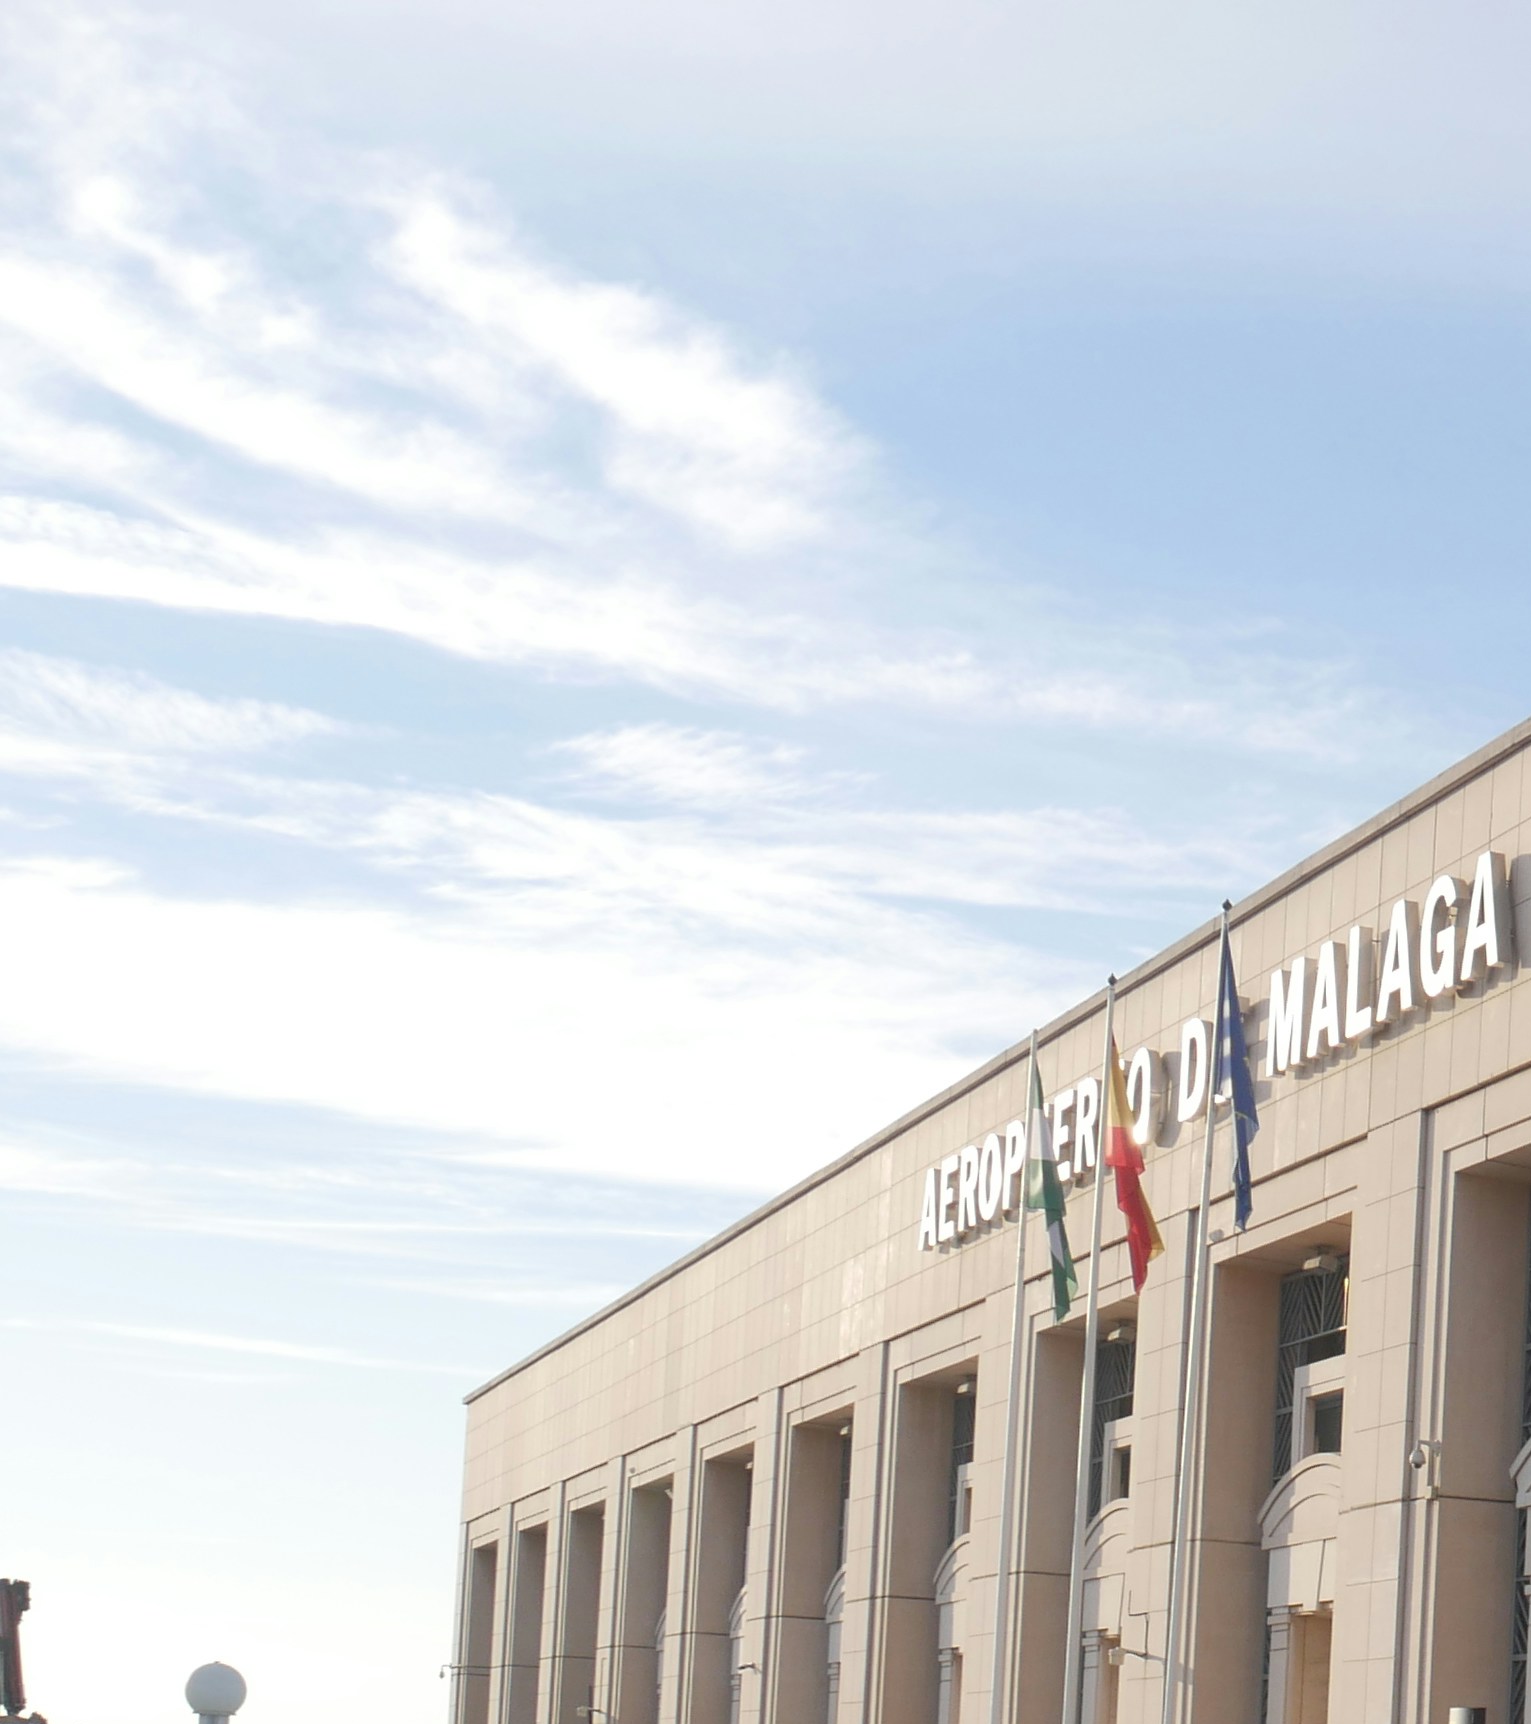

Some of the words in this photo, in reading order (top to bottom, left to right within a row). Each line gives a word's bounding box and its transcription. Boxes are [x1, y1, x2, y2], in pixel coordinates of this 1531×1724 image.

[917, 1046, 1152, 1253] AEROPERO
[1178, 1014, 1233, 1123] D
[1265, 850, 1500, 1078] MALAGA
